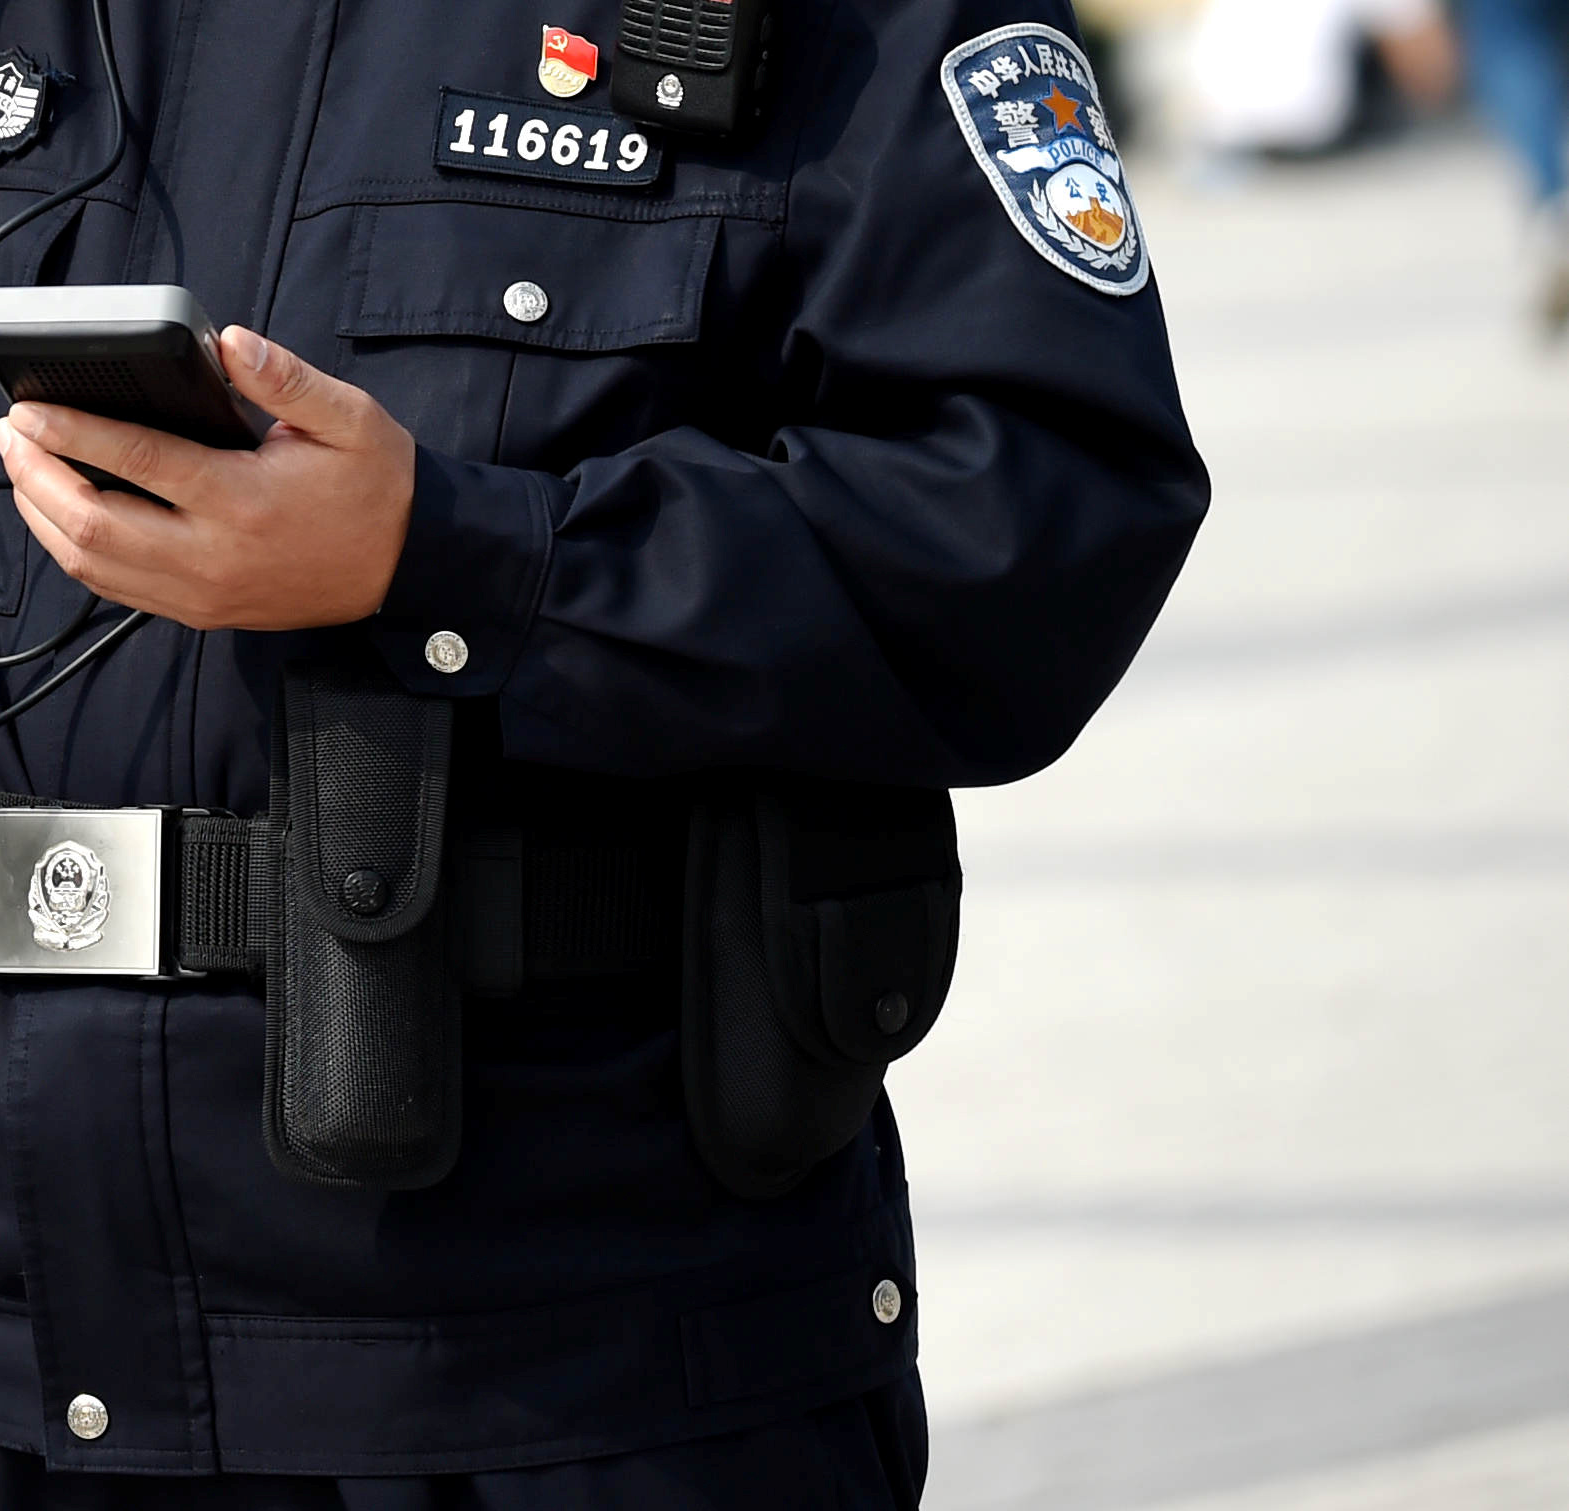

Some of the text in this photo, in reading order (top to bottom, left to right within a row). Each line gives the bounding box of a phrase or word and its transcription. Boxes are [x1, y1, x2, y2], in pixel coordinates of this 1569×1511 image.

[968, 44, 1091, 99] 中华人民共和
[449, 109, 649, 173] 116619
[1048, 139, 1105, 170] POLICE
